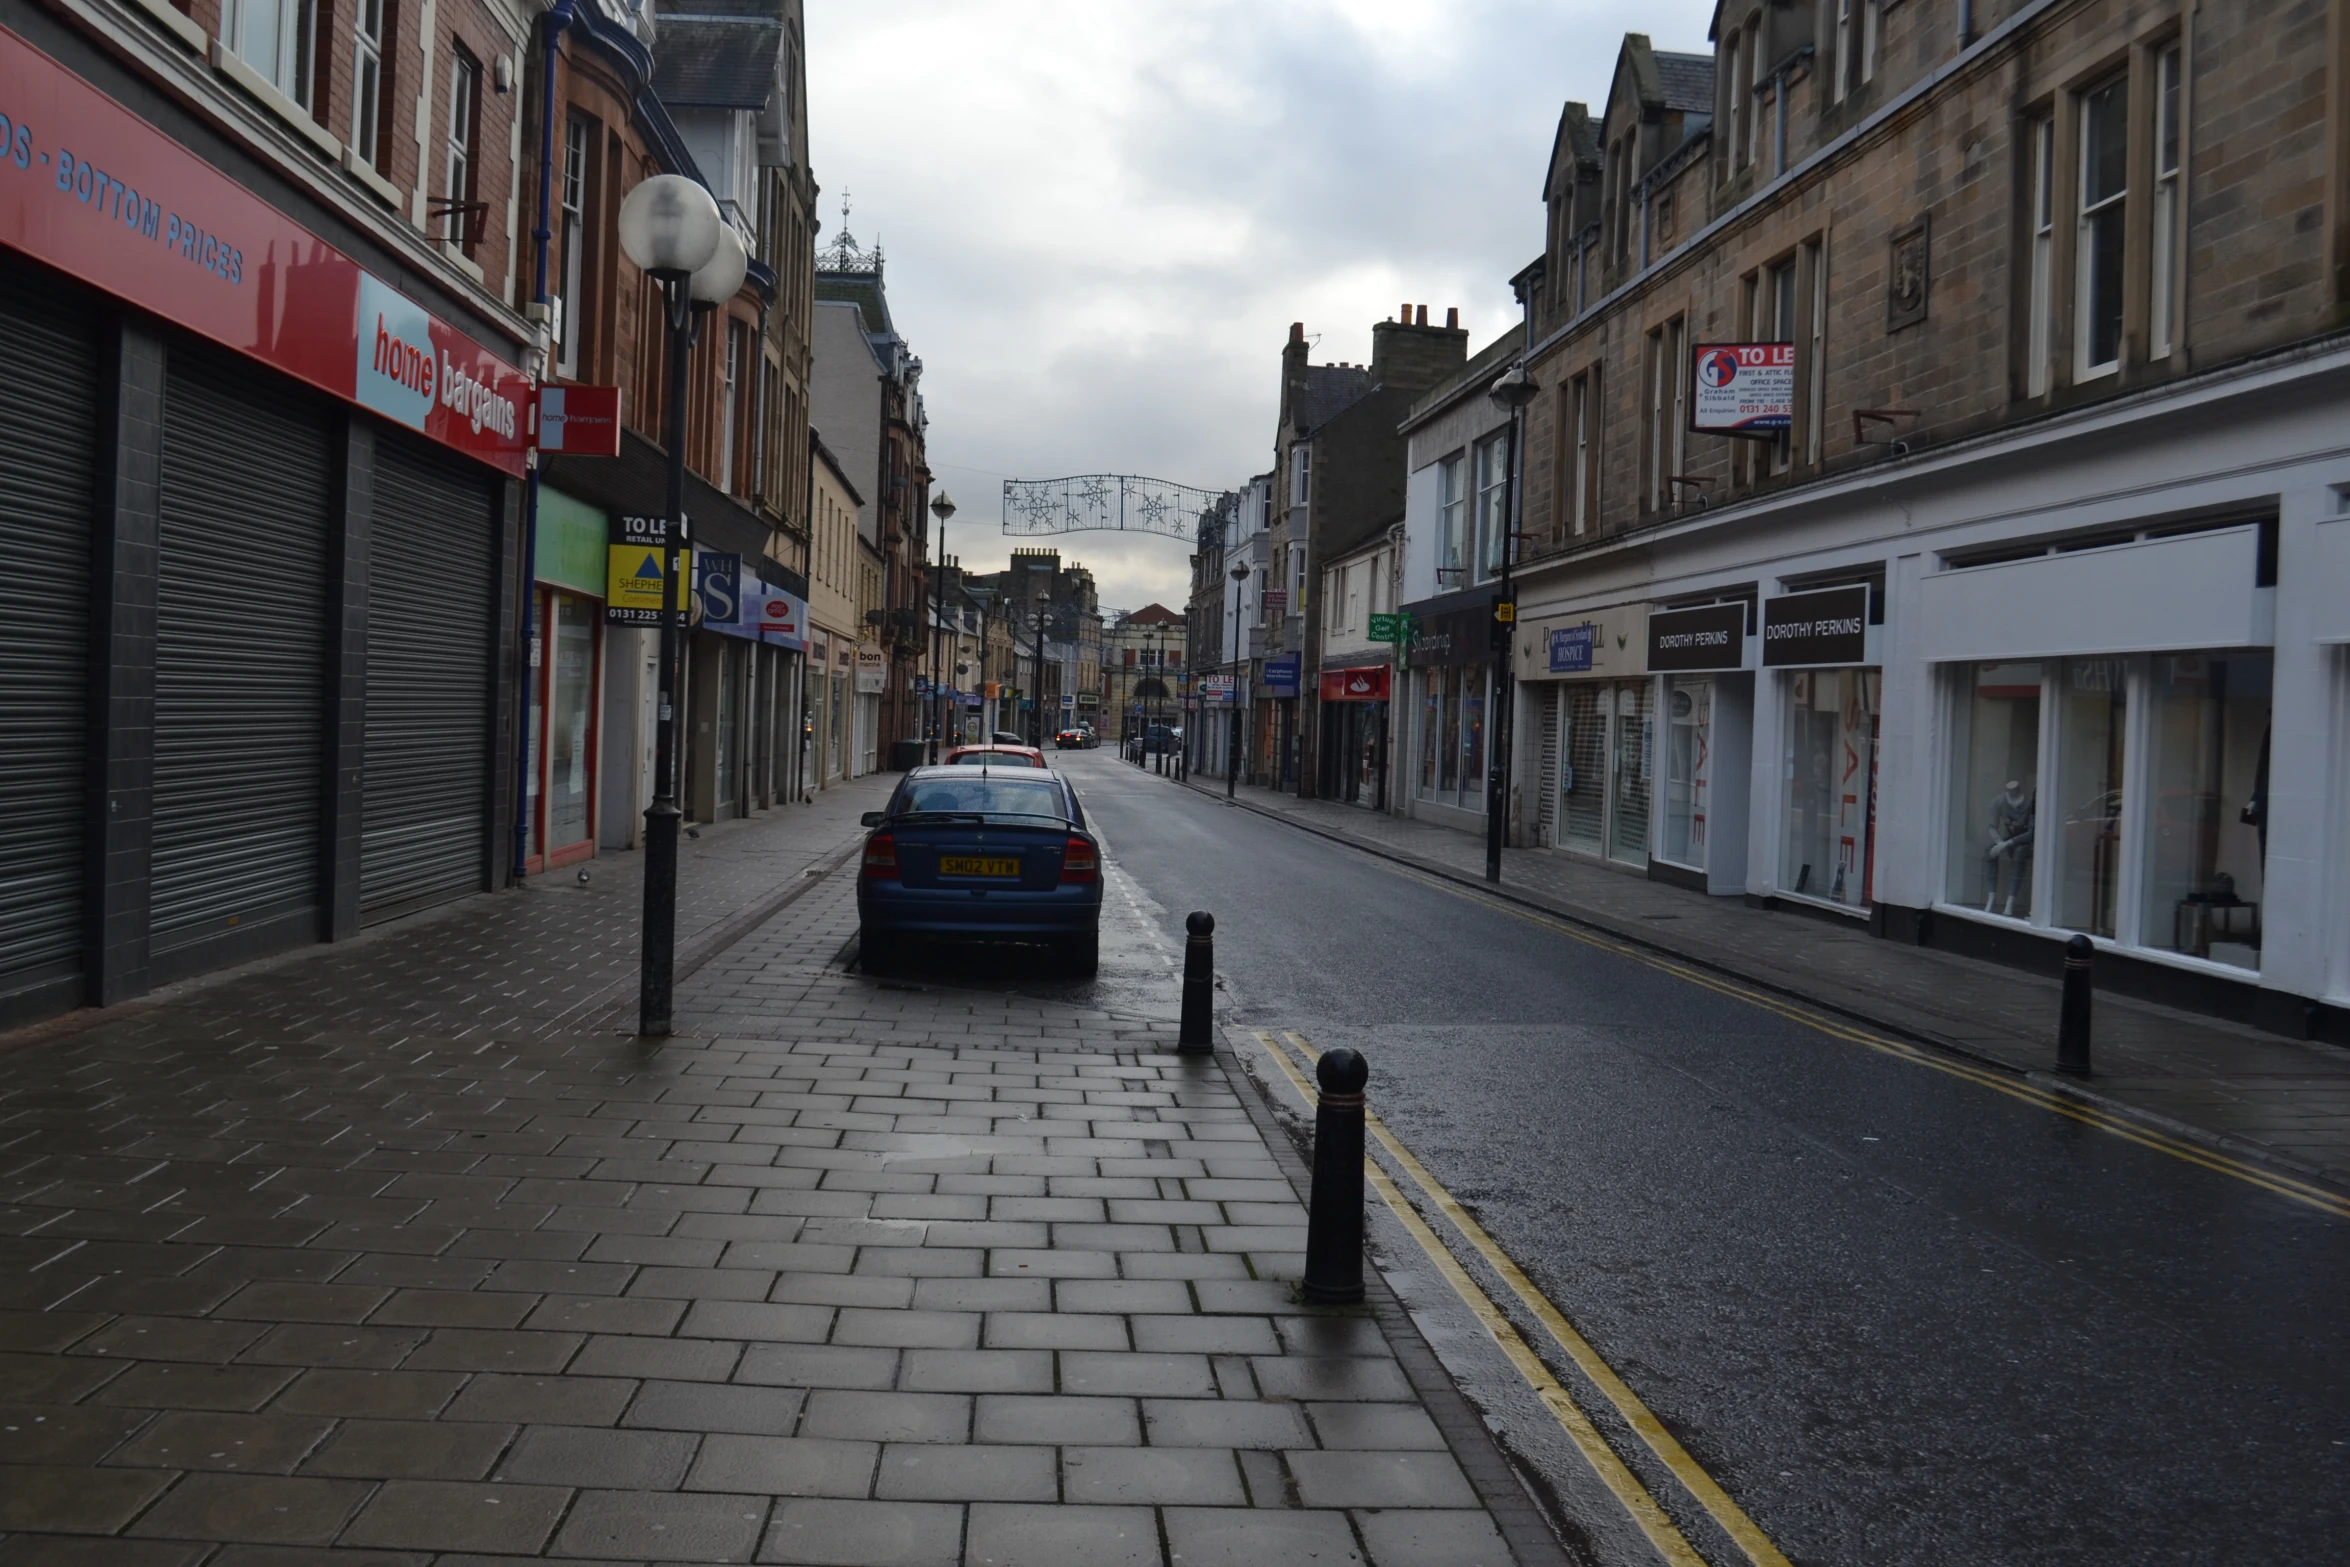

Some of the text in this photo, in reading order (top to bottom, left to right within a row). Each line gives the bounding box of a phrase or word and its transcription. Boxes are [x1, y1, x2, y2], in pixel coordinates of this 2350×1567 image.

[56, 148, 162, 241] BOTTOM
[167, 213, 243, 285] PRICES
[373, 312, 433, 397] home
[1738, 347, 1794, 365] TO LE
[441, 349, 515, 440] bargains
[1740, 405, 1759, 413] 0131
[541, 413, 566, 423] home
[623, 516, 666, 534] TO LE
[626, 535, 654, 543] RETAIL
[703, 558, 733, 572] WH
[618, 578, 664, 590] SHEPHE
[703, 572, 734, 620] S
[609, 608, 635, 619] 0131
[637, 610, 658, 620] 225
[1370, 615, 1397, 625] Virtual
[1371, 631, 1395, 640] Centre
[1766, 616, 1862, 641] DOROTHY PERKINS
[1659, 630, 1729, 649] DOROTHY PERKINS
[859, 651, 881, 661] bon
[1557, 644, 1584, 662] HOSPICE
[1207, 675, 1233, 683] TO LE
[1840, 697, 1860, 874] SALE
